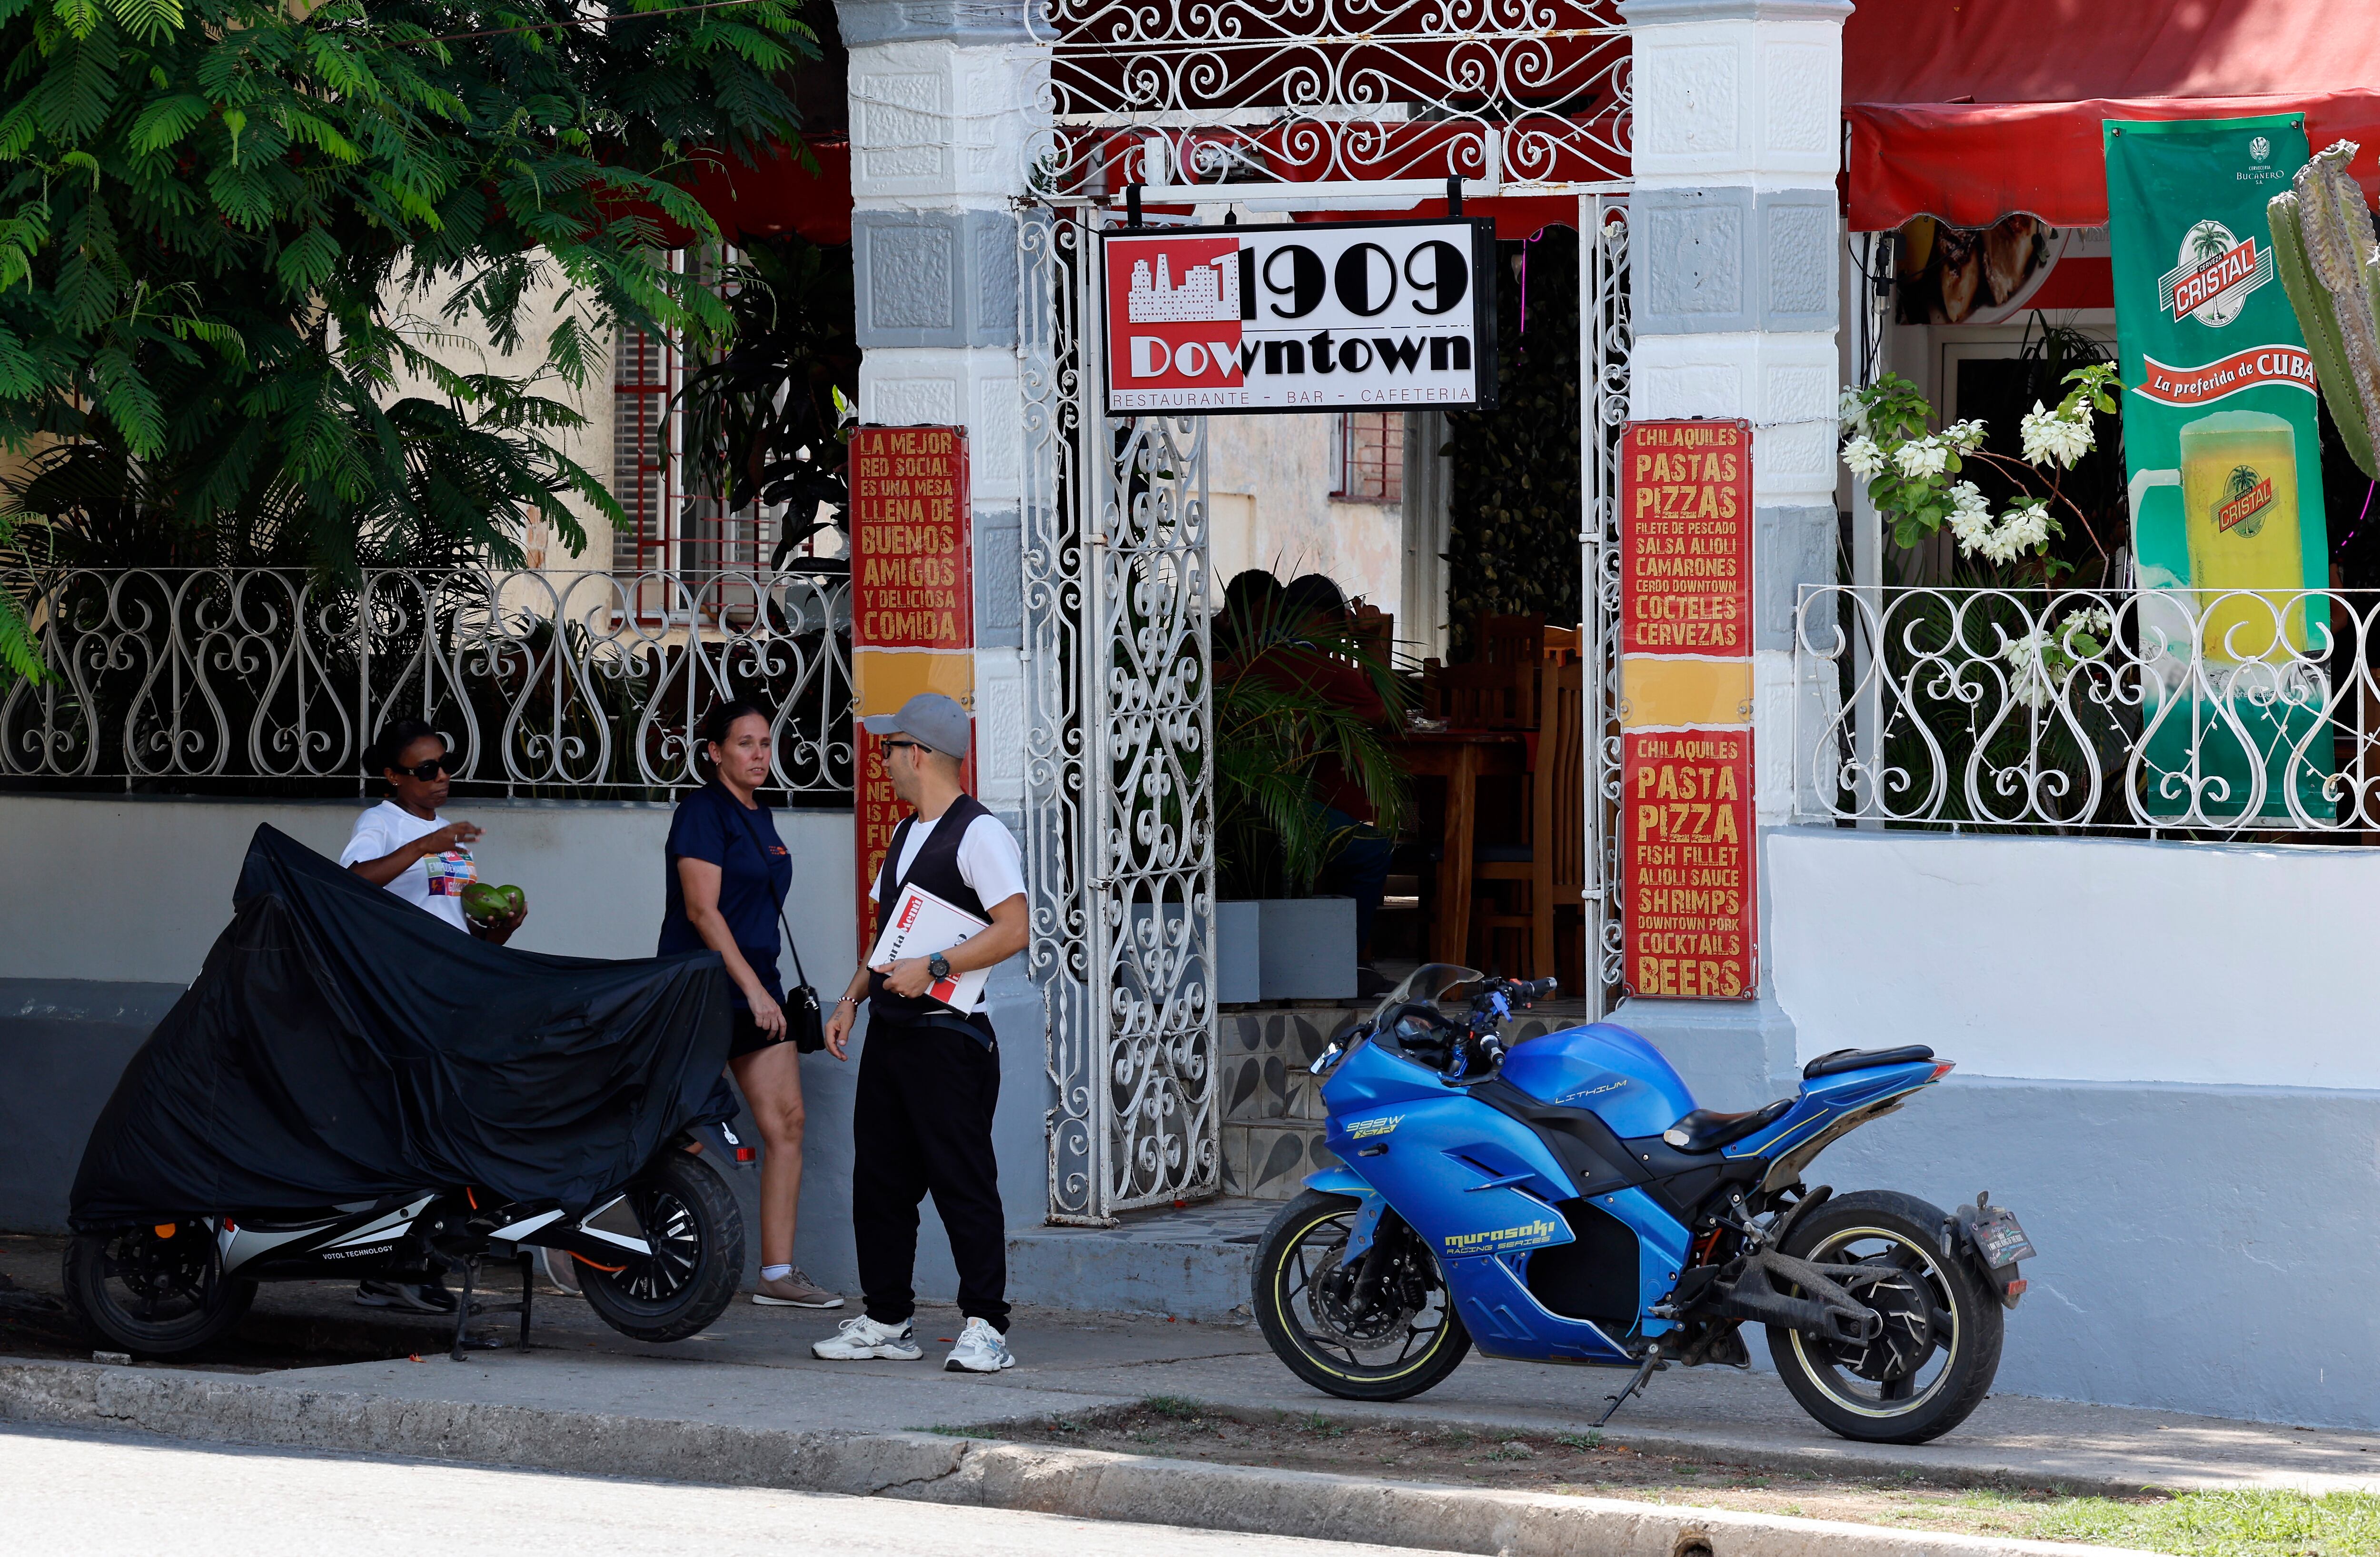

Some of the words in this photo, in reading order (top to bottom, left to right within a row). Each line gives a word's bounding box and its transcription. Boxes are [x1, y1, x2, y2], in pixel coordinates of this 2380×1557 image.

[2237, 170, 2284, 180] BUCANERO
[2199, 254, 2223, 272] CERVEZA
[1211, 240, 1468, 320] 1909
[2176, 249, 2254, 312] CRISTAL
[2201, 316, 2223, 324] PREFERIDA
[2229, 306, 2239, 318] CUBA
[1130, 329, 1471, 378] Downtown
[2154, 375, 2170, 392] La
[2174, 369, 2235, 397] preferida
[2238, 362, 2254, 377] de
[2257, 354, 2314, 384] CUBA
[1113, 392, 1250, 406] RESTAURANTE
[1288, 390, 1324, 404] BAR
[1361, 388, 1471, 402] CAFETERIA
[861, 434, 883, 454] LA
[891, 433, 952, 454] MEJOR
[1637, 428, 1736, 449] CHILAQUILES
[861, 458, 889, 476] RED
[895, 457, 953, 476] SOCIAL
[1637, 453, 1736, 482] PASTAS
[861, 480, 876, 496] ES
[882, 480, 910, 495] UNA
[915, 479, 952, 495] MESA
[2236, 487, 2252, 500] CERVEZA
[862, 499, 923, 522] LLENA
[932, 499, 953, 521] DE
[1636, 486, 1736, 519] PIZZAS
[2221, 484, 2271, 527] CRISTAL
[1636, 523, 1668, 534] FILETE
[1672, 522, 1684, 534] DE
[1689, 522, 1736, 534] PESCADO
[862, 526, 954, 554] BUENOS
[1636, 538, 1685, 554] SALSA
[1691, 538, 1736, 554] ALIOLI
[863, 558, 955, 587] AMIGOS
[1636, 558, 1736, 576] CAMARONES
[1636, 580, 1669, 592] CERDO
[1674, 579, 1736, 592] DOWNTOWN
[863, 590, 873, 607] Y
[880, 590, 955, 608] DELICIOSA
[1636, 595, 1736, 619] COCTELES
[864, 611, 957, 640] COMIDA
[1636, 623, 1736, 645] CERVEZAS
[1638, 739, 1737, 761] CHILAQUILES
[1638, 765, 1737, 800] PASTA
[1638, 803, 1737, 844] PIZZA
[1638, 846, 1675, 865] FISH
[1684, 847, 1738, 866] FILLET
[1639, 868, 1686, 885] ALIOLI
[1691, 869, 1738, 887] SAUCE
[1638, 888, 1739, 915] SHRIMPS
[1638, 916, 1705, 929] DOWNTOWN
[1710, 918, 1738, 930] PORK
[1639, 932, 1739, 955] COCKTAILS
[1639, 957, 1740, 996] BEERS
[1555, 1080, 1627, 1104] LITHIUM
[1445, 1220, 1555, 1248] murasaki
[345, 1245, 393, 1258] TECHNOLOGY
[1447, 1244, 1493, 1255] RACING
[1497, 1236, 1551, 1249] SERIES
